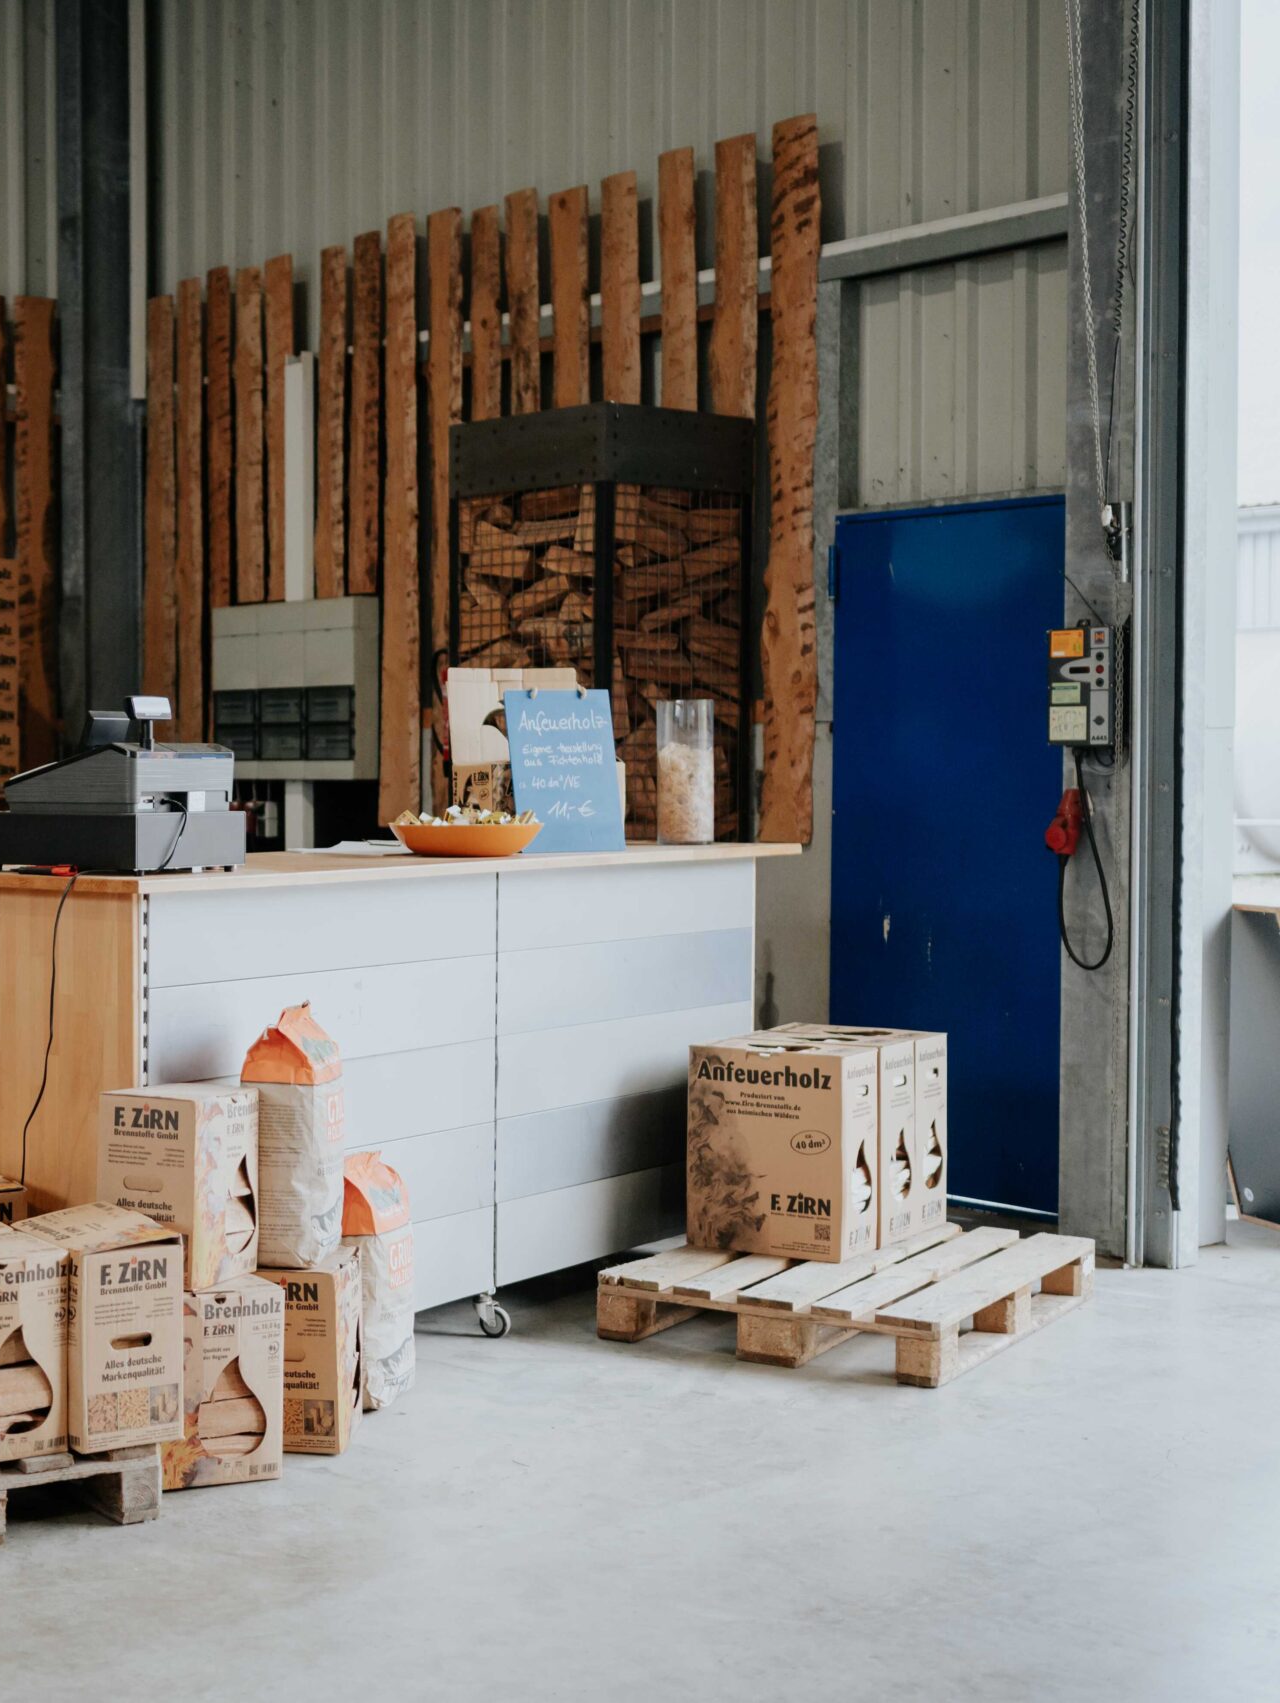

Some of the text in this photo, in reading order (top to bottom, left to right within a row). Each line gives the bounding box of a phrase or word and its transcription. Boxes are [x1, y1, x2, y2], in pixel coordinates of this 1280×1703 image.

[518, 709, 608, 737] Anfeuerholz
[577, 799, 596, 817] €
[697, 1061, 832, 1091] Anfeuerholz
[740, 1091, 772, 1101] Produziert
[114, 1103, 179, 1132] F. ZiRN
[738, 1108, 772, 1118] heimischen
[774, 1111, 800, 1120] Wäldern
[114, 1128, 179, 1141] Brennstoffe GmbH
[795, 1140, 807, 1149] 40
[117, 1198, 172, 1211] Alles deutsche
[770, 1192, 831, 1217] F. ZiRN
[100, 1257, 167, 1286] F. ZiRN
[100, 1281, 167, 1296] Brennstoffe GmbH
[204, 1297, 280, 1320] Brennholz
[296, 1303, 319, 1311] GmbH
[212, 1323, 235, 1336] ZiRN
[105, 1353, 162, 1370] Alles deutsche
[102, 1365, 165, 1382] Markenqualität!
